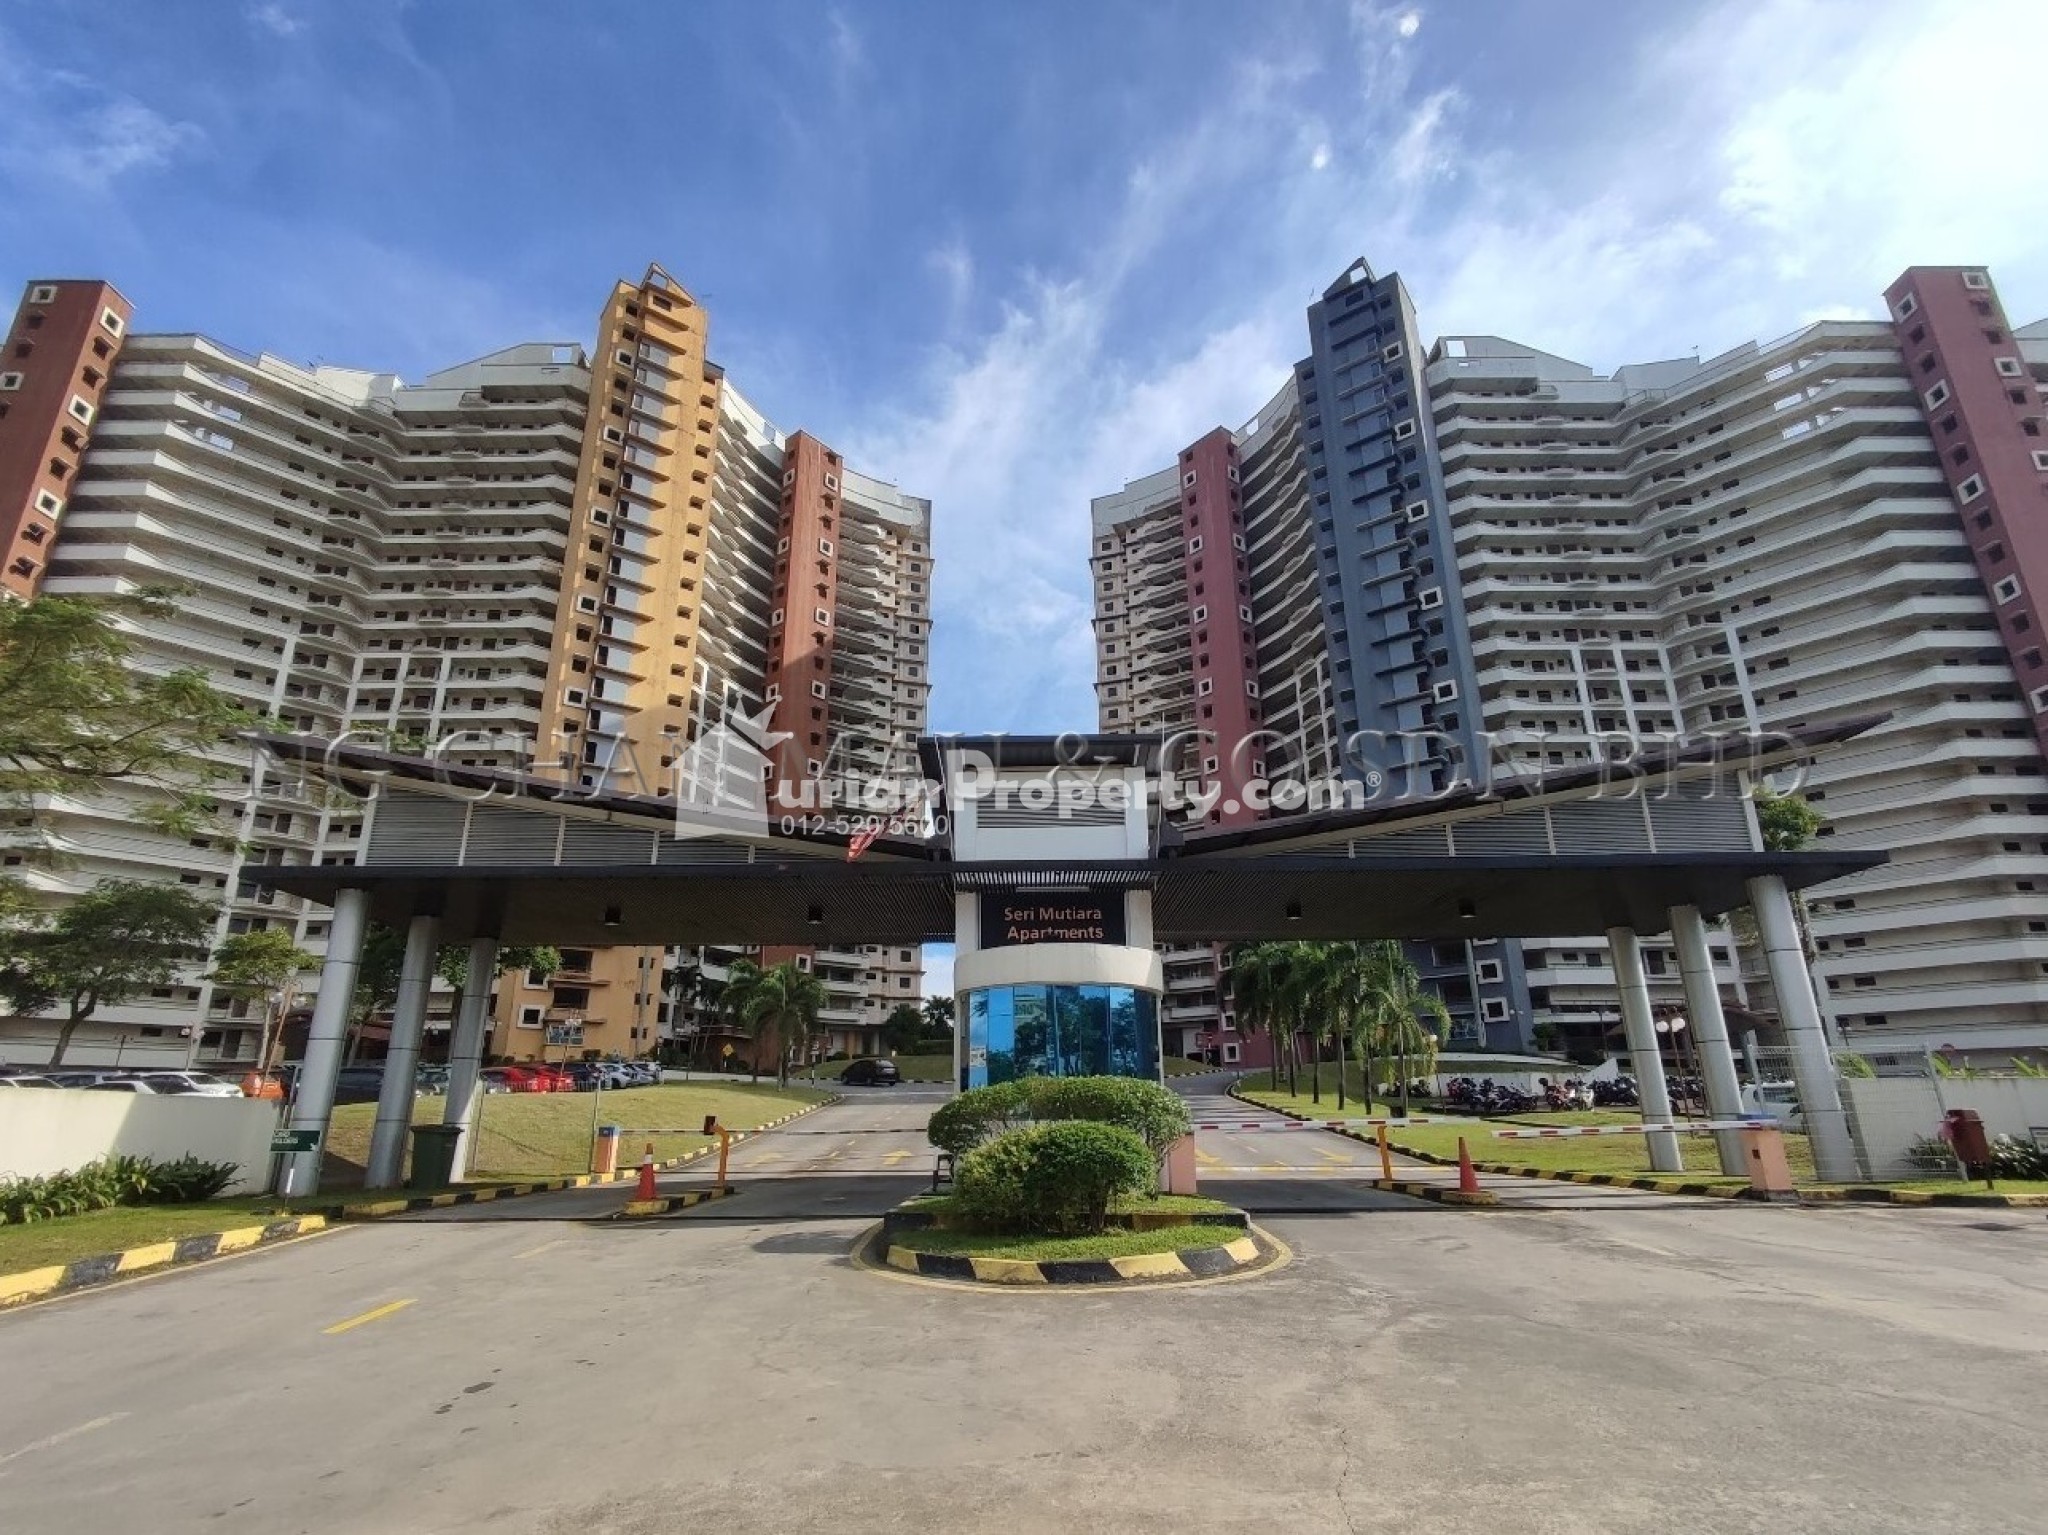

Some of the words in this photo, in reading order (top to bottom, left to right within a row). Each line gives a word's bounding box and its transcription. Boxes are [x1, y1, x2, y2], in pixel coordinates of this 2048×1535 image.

[1004, 907, 1035, 921] Seri
[1039, 907, 1102, 921] Mutiara
[1007, 926, 1105, 943] Apartments
